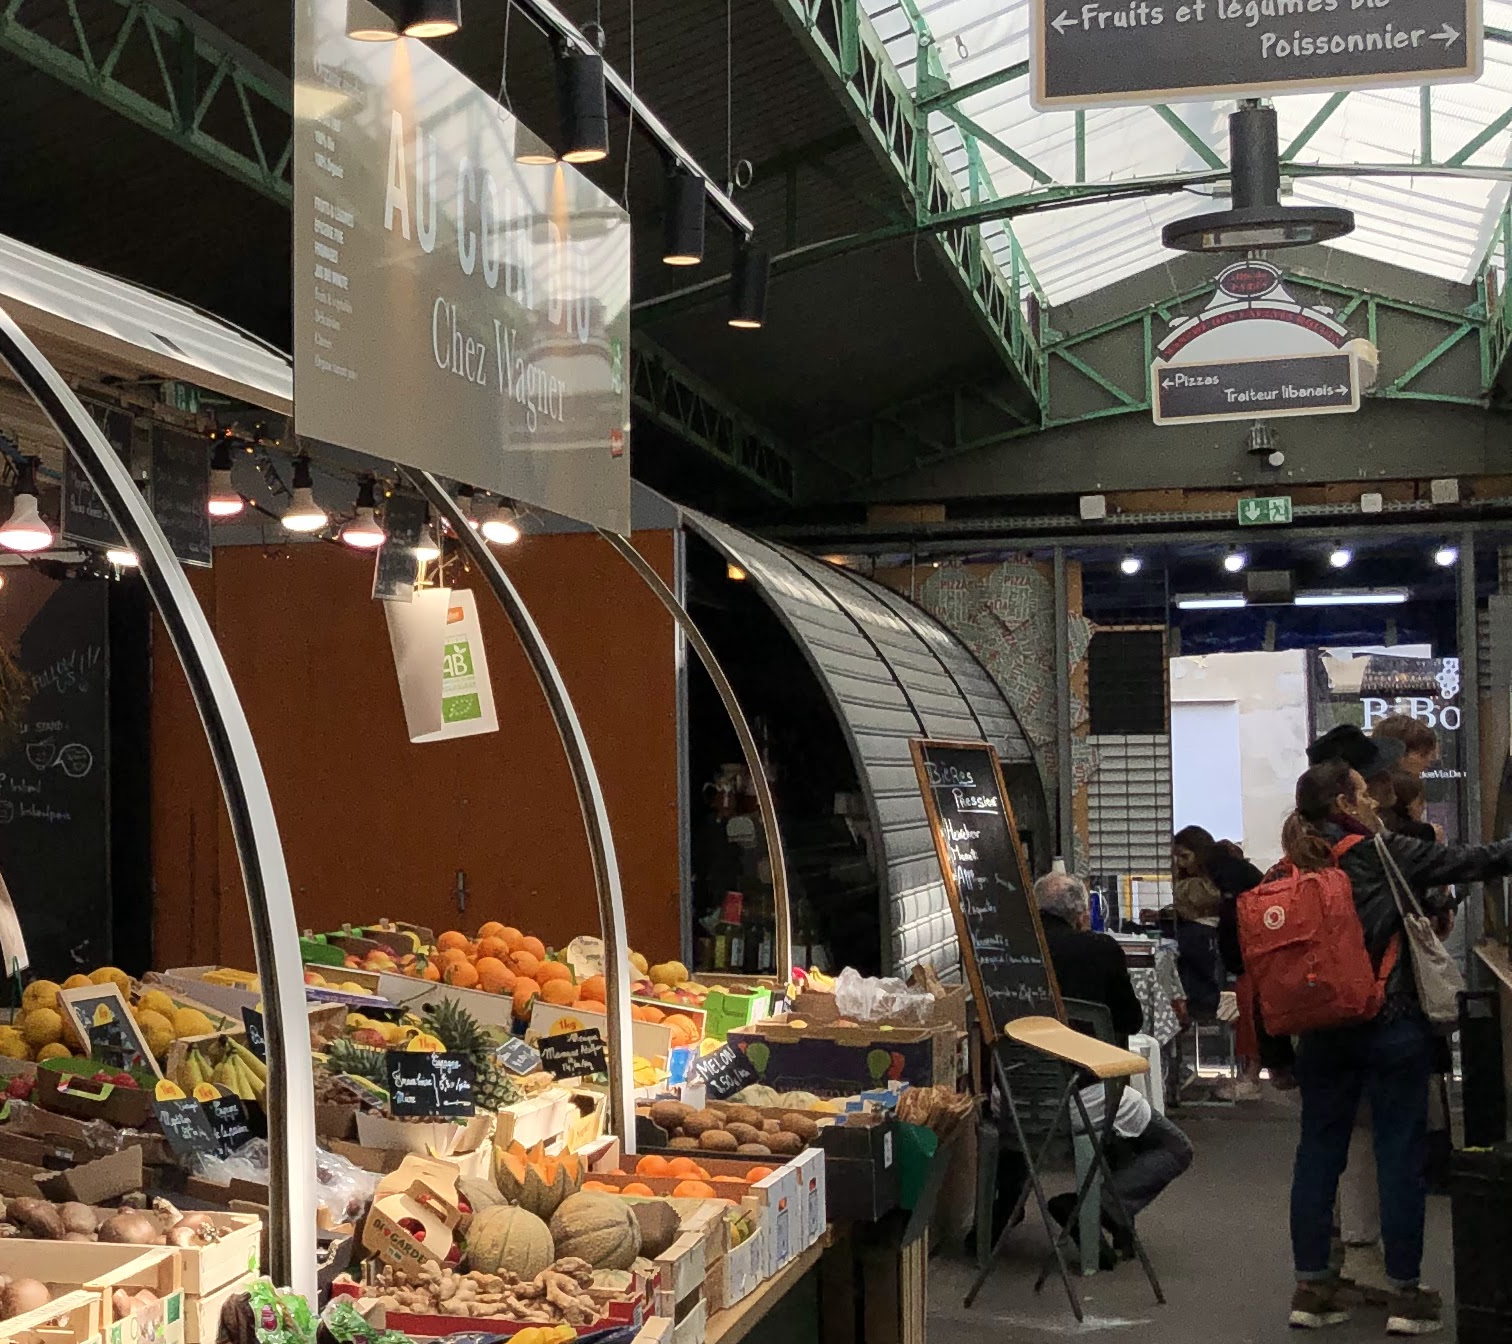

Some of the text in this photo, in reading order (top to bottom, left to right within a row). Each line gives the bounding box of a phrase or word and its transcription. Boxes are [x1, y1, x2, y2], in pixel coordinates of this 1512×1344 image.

[1081, 0, 1164, 32] Fruits
[1260, 25, 1426, 59] Poissonnier
[384, 109, 438, 254] AU
[457, 156, 534, 311] COIN
[432, 296, 487, 386] Chez
[493, 318, 567, 433] Wagner
[1175, 372, 1220, 388] Pizzas
[1224, 384, 1336, 403] Traiteur libanais
[696, 1044, 737, 1080] MELON
